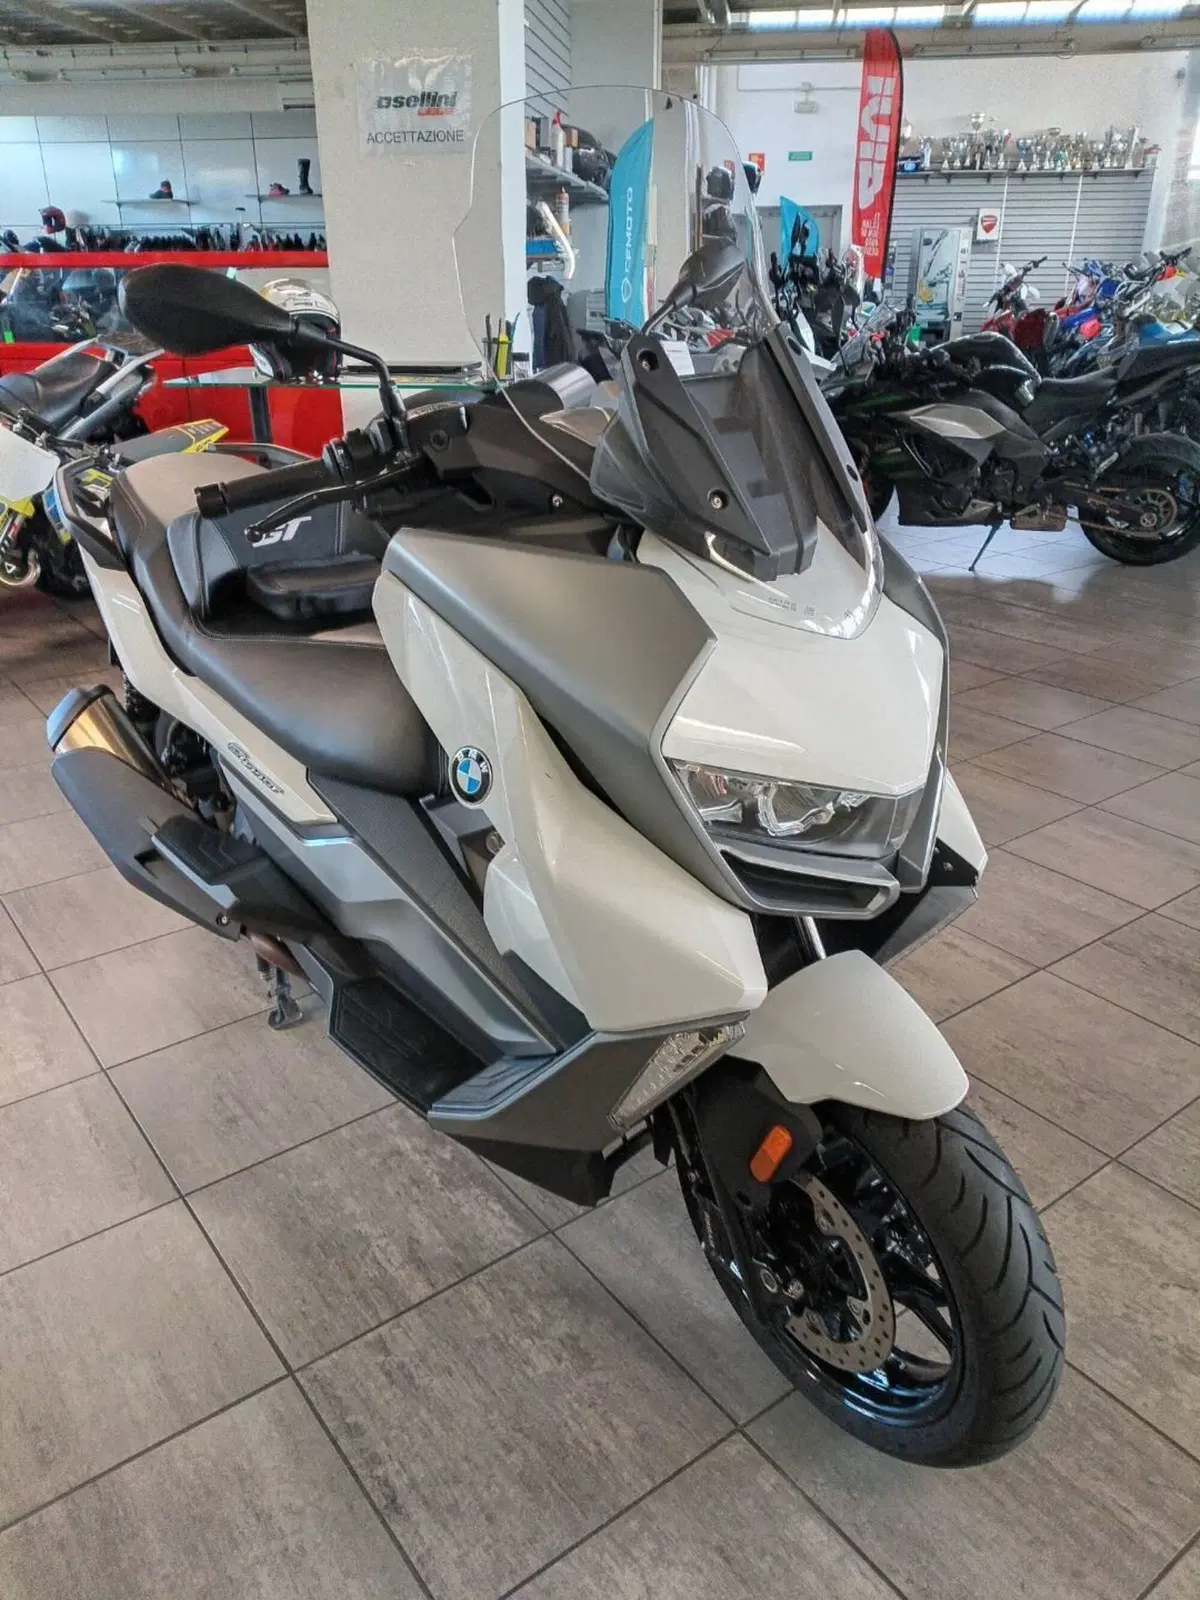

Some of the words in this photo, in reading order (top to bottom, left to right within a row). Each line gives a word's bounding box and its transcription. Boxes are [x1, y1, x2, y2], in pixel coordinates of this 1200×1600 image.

[366, 129, 465, 144] ACCETTAZIONE
[623, 187, 634, 274] CFMOTO
[457, 748, 489, 773] BMW
